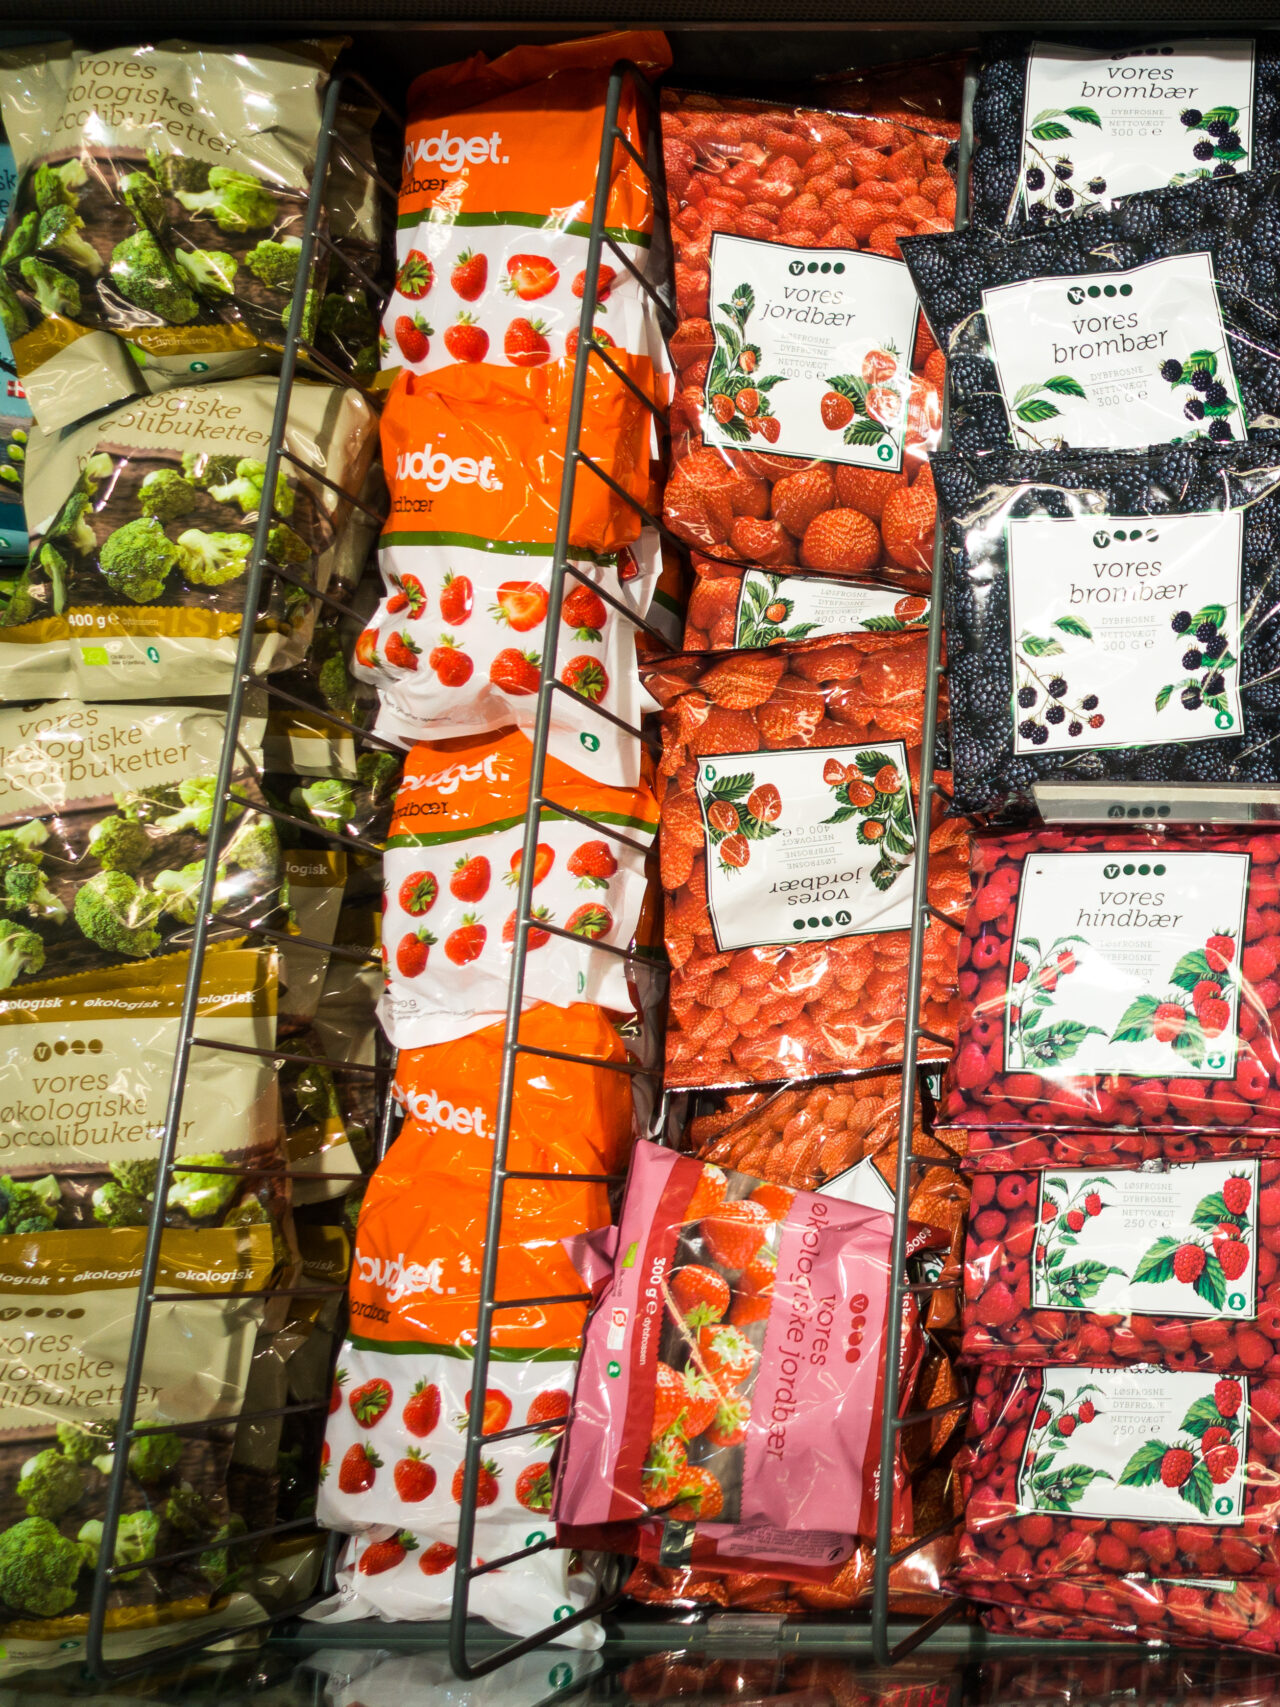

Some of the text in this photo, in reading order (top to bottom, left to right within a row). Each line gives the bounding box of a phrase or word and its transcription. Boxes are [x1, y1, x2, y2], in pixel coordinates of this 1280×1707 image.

[79, 60, 158, 81] vores
[1107, 66, 1174, 80] vores
[1080, 81, 1199, 100] brombær
[1111, 128, 1134, 137] 300
[783, 286, 845, 305] vores
[760, 300, 857, 328] jordbær
[1073, 312, 1139, 335] vores
[1053, 329, 1169, 364] brombær
[1097, 395, 1120, 408] 300
[1093, 561, 1162, 578] vores
[68, 614, 94, 626] 400
[96, 615, 106, 629] g
[18, 708, 99, 738] vores
[768, 868, 862, 893] jordbær
[787, 887, 851, 905] vores
[1099, 891, 1166, 906] vores
[1076, 909, 1183, 929] hindbær
[83, 998, 161, 1011] økologisk
[32, 1072, 109, 1095] vores
[0, 1093, 148, 1133] økologiske
[1123, 1219, 1146, 1229] 250
[73, 1267, 142, 1283] økologis
[175, 1268, 255, 1284] økologisk
[650, 1256, 666, 1285] 300
[767, 1201, 829, 1462] økologiske jordbær
[809, 1293, 836, 1367] vores
[1112, 1424, 1135, 1436] 250
